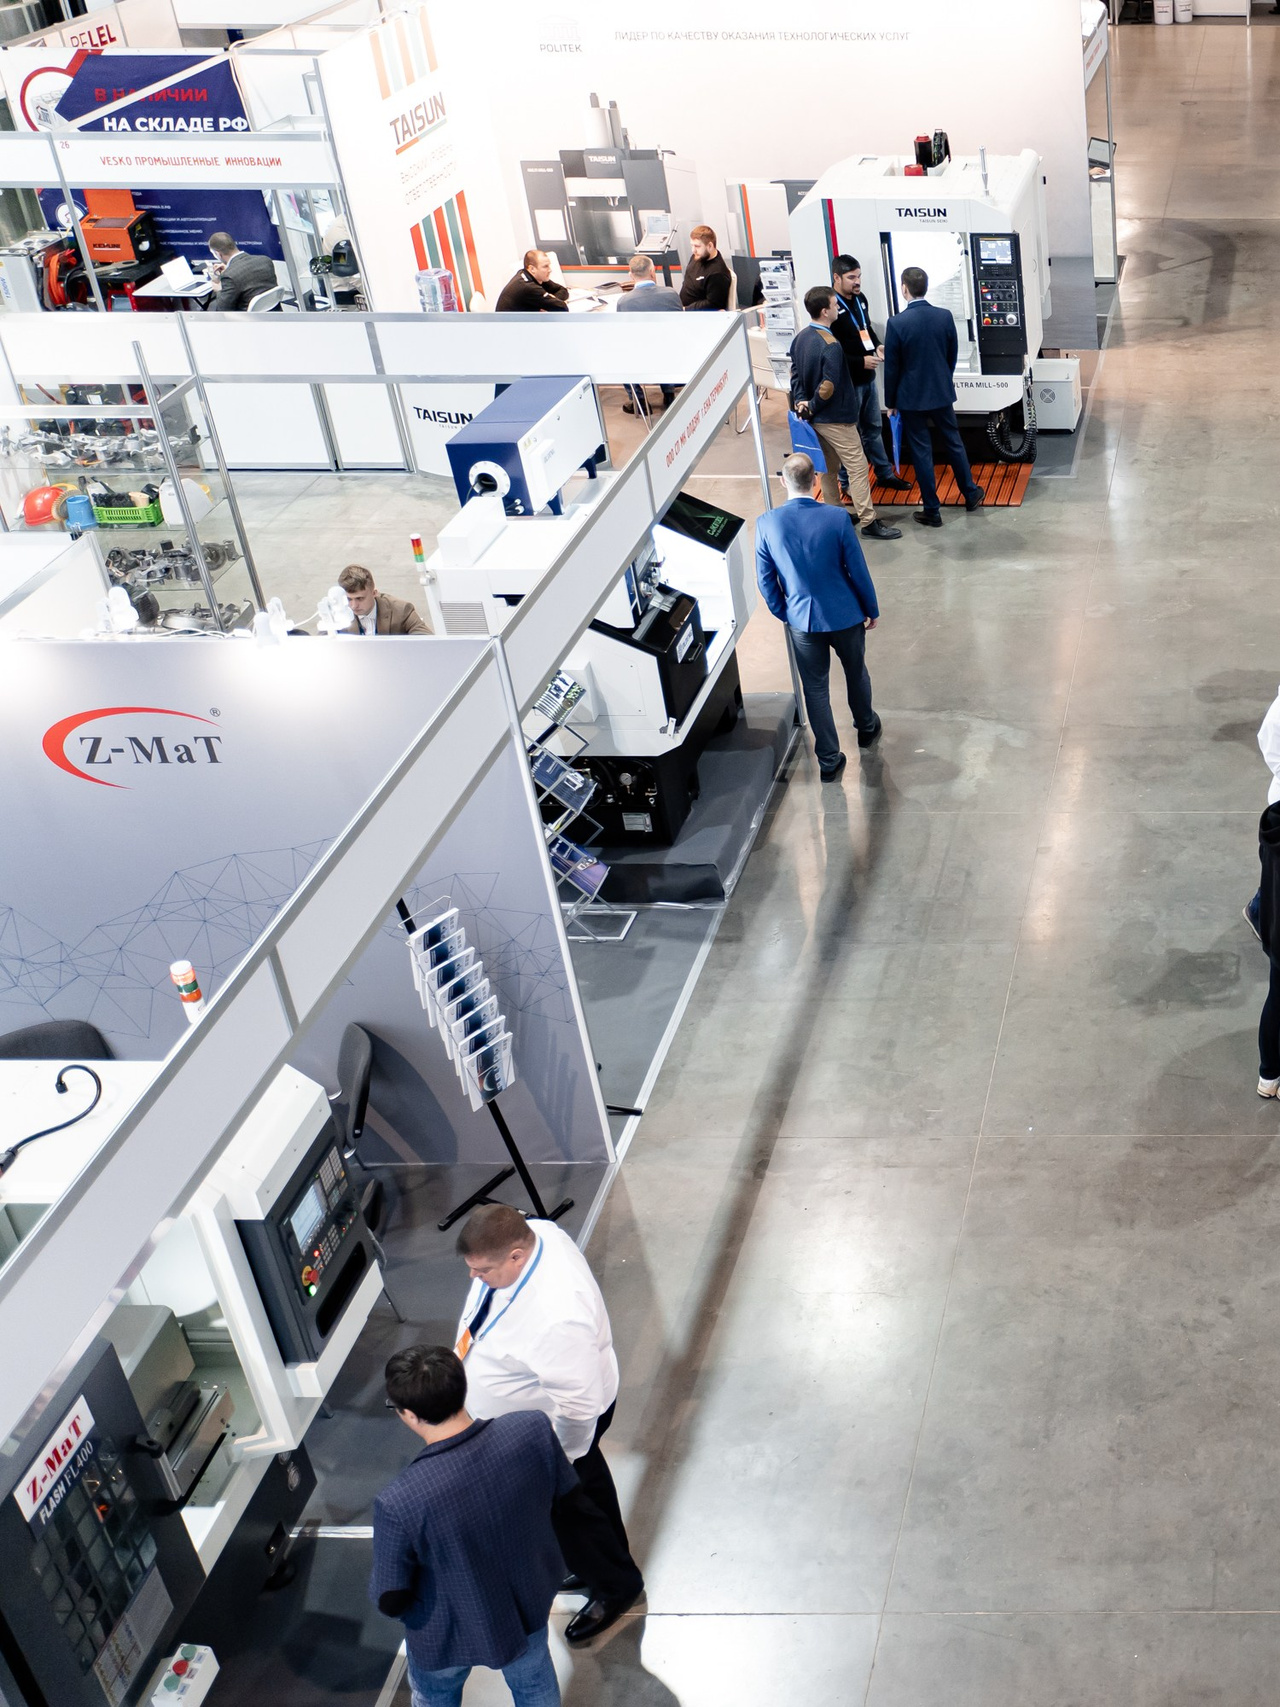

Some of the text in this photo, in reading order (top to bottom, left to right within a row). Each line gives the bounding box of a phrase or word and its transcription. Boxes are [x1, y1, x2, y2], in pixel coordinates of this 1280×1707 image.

[615, 31, 910, 41] ЛИДЕР ПО КАЧЕСТВУ ОКАЗАНИЯ ТЕХНОЛОГИЧЕСКИХ УСЛУГ
[540, 44, 582, 52] POLITEK
[112, 88, 208, 102] НАИЧИИ
[104, 117, 248, 132] НА СКЛАДЕ РФ
[389, 91, 446, 145] TAISUN
[60, 141, 70, 149] 26
[100, 156, 282, 168] VESKO ПРОМЫШЛЕННЫЕ ИННОВАЦИИ
[895, 208, 947, 217] TAISUN
[413, 406, 474, 425] TAISUN
[79, 736, 223, 764] Z-MaT
[27, 1415, 82, 1505] Z-MaT
[39, 1481, 67, 1525] FLASH
